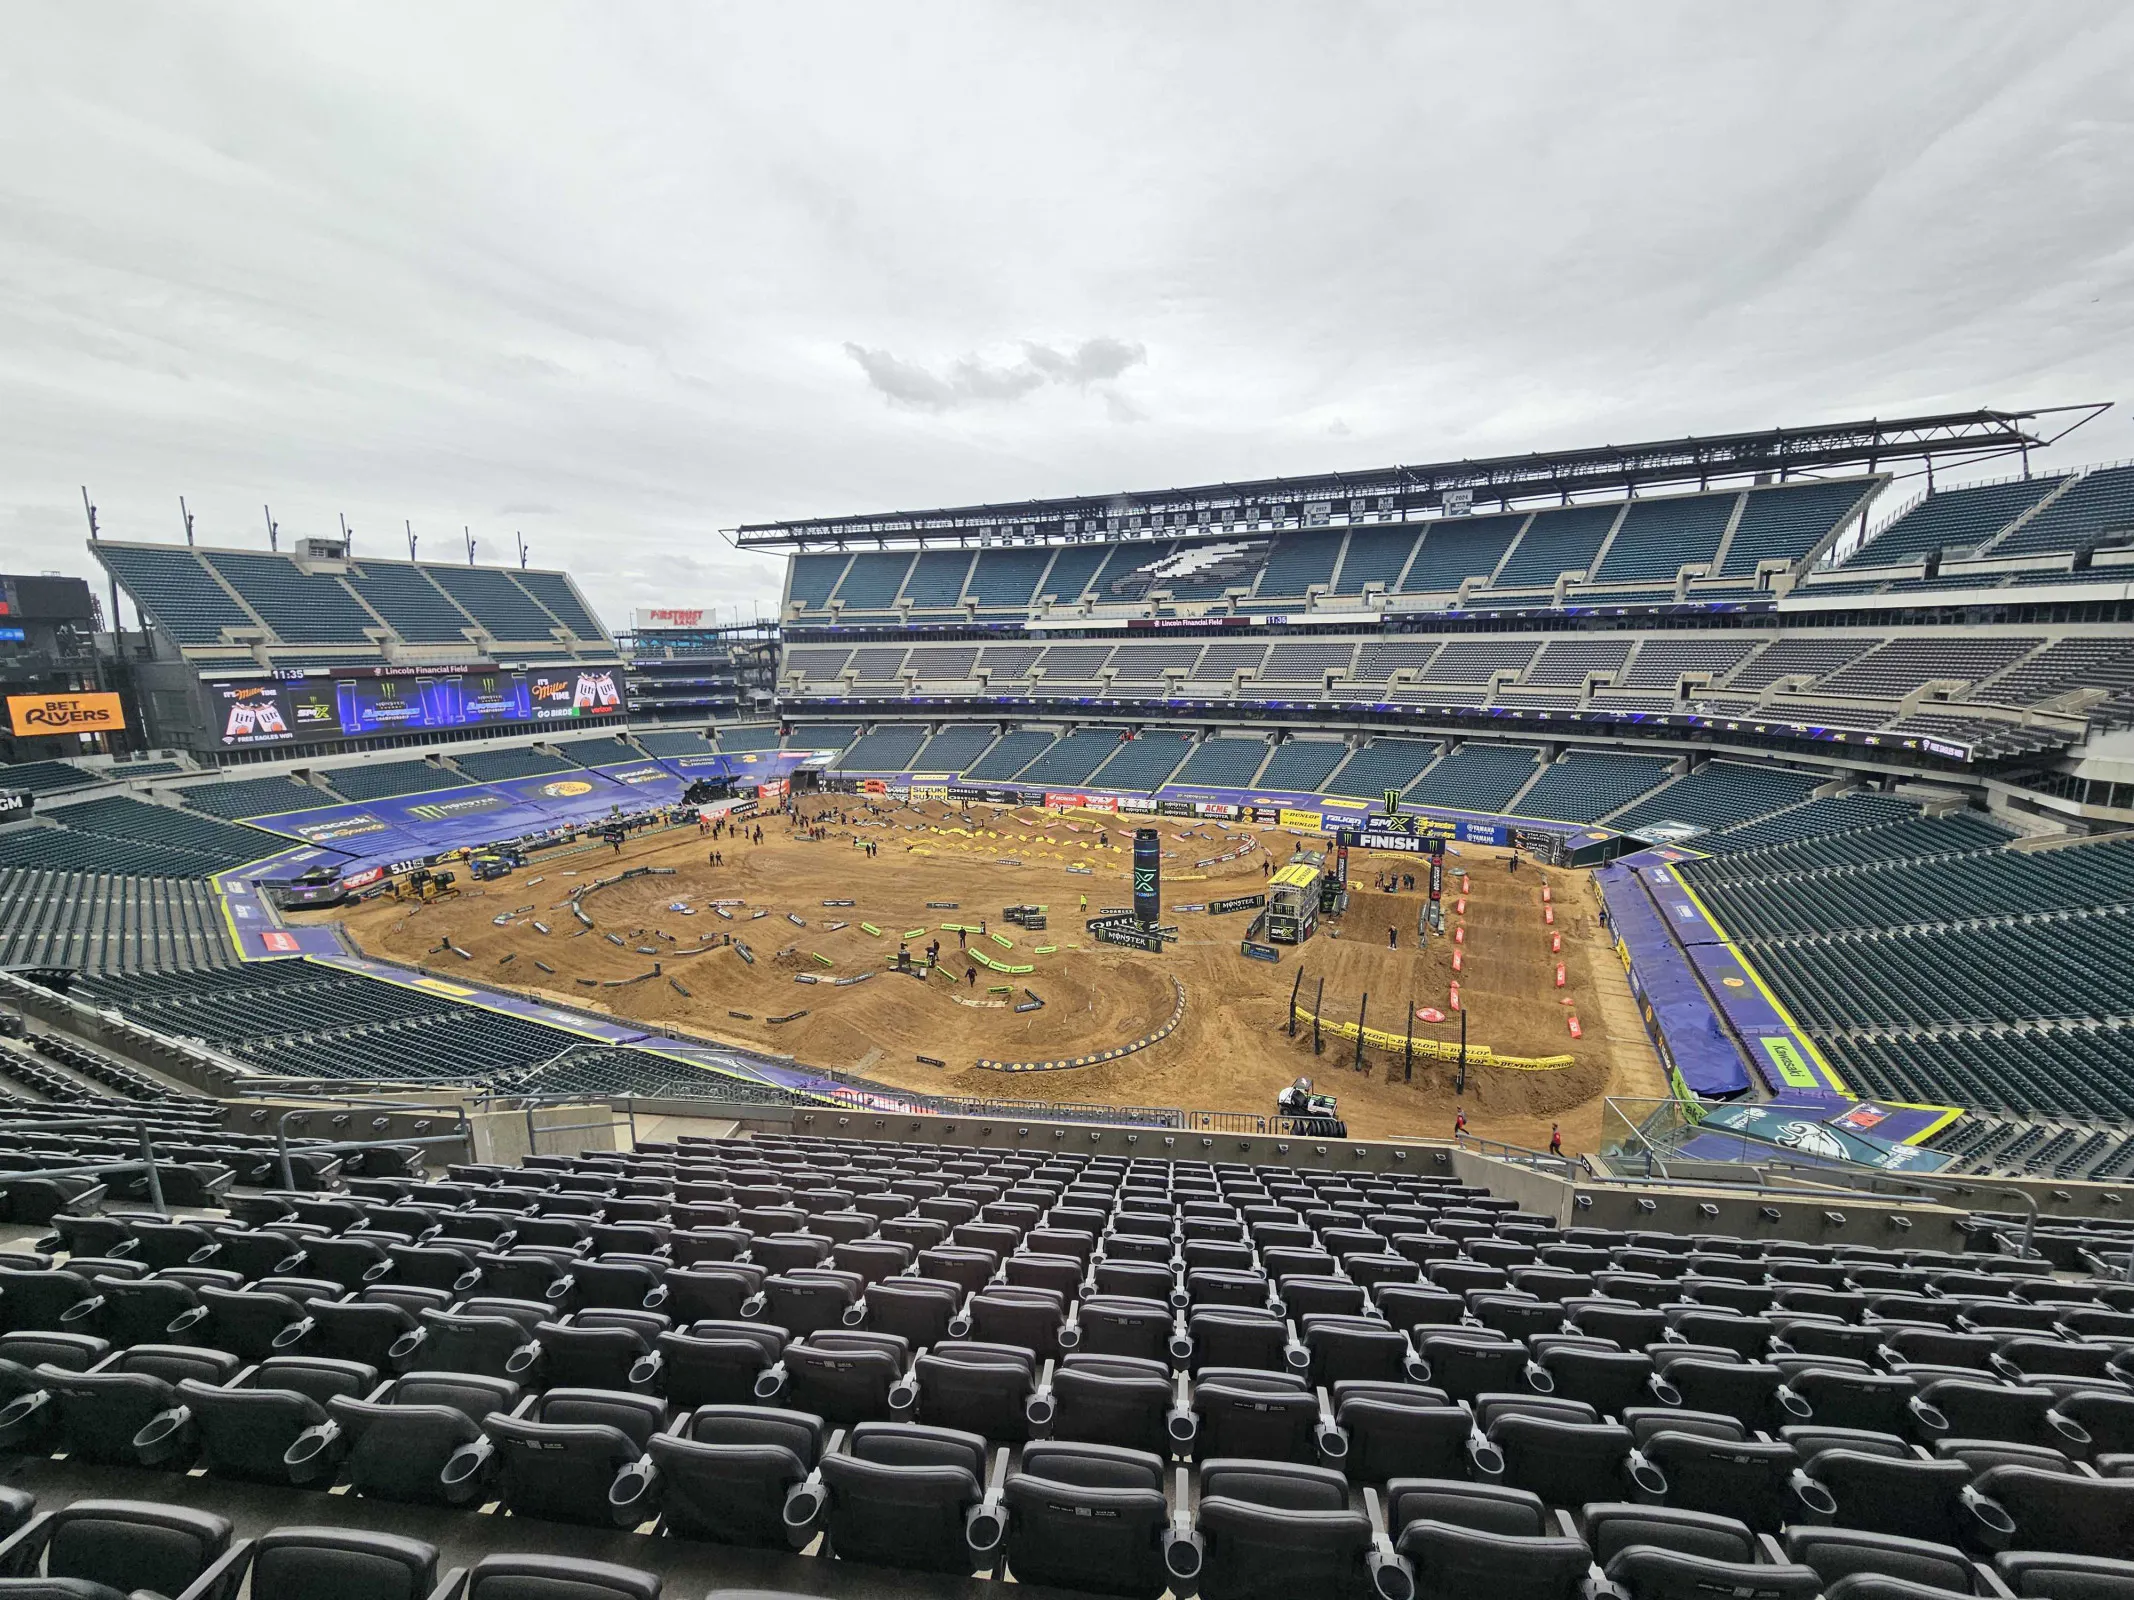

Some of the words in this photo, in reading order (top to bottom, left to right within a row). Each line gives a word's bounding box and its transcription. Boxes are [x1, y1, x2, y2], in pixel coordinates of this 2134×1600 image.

[1161, 618, 1182, 626] Lincoln
[1182, 618, 1208, 626] Financial
[273, 670, 304, 679] 11:35
[386, 667, 415, 675] Lincoln
[416, 666, 450, 674] Financial
[532, 681, 568, 700] Miller
[580, 684, 595, 695] Lite
[600, 683, 614, 695] Lite
[552, 691, 570, 700] TIME
[45, 701, 80, 711] BET
[235, 713, 254, 724] Lite
[538, 710, 550, 718] GO
[1205, 805, 1228, 813] ACME
[298, 815, 369, 836] peacock
[1369, 817, 1409, 831] SMX
[1472, 825, 1495, 833] YAMAHA
[1360, 834, 1419, 851] FINISH
[1472, 834, 1494, 842] YAMAHA
[1222, 899, 1254, 908] MONSTER
[1108, 932, 1146, 946] MONSTER
[1772, 1045, 1806, 1078] Kawasaki
